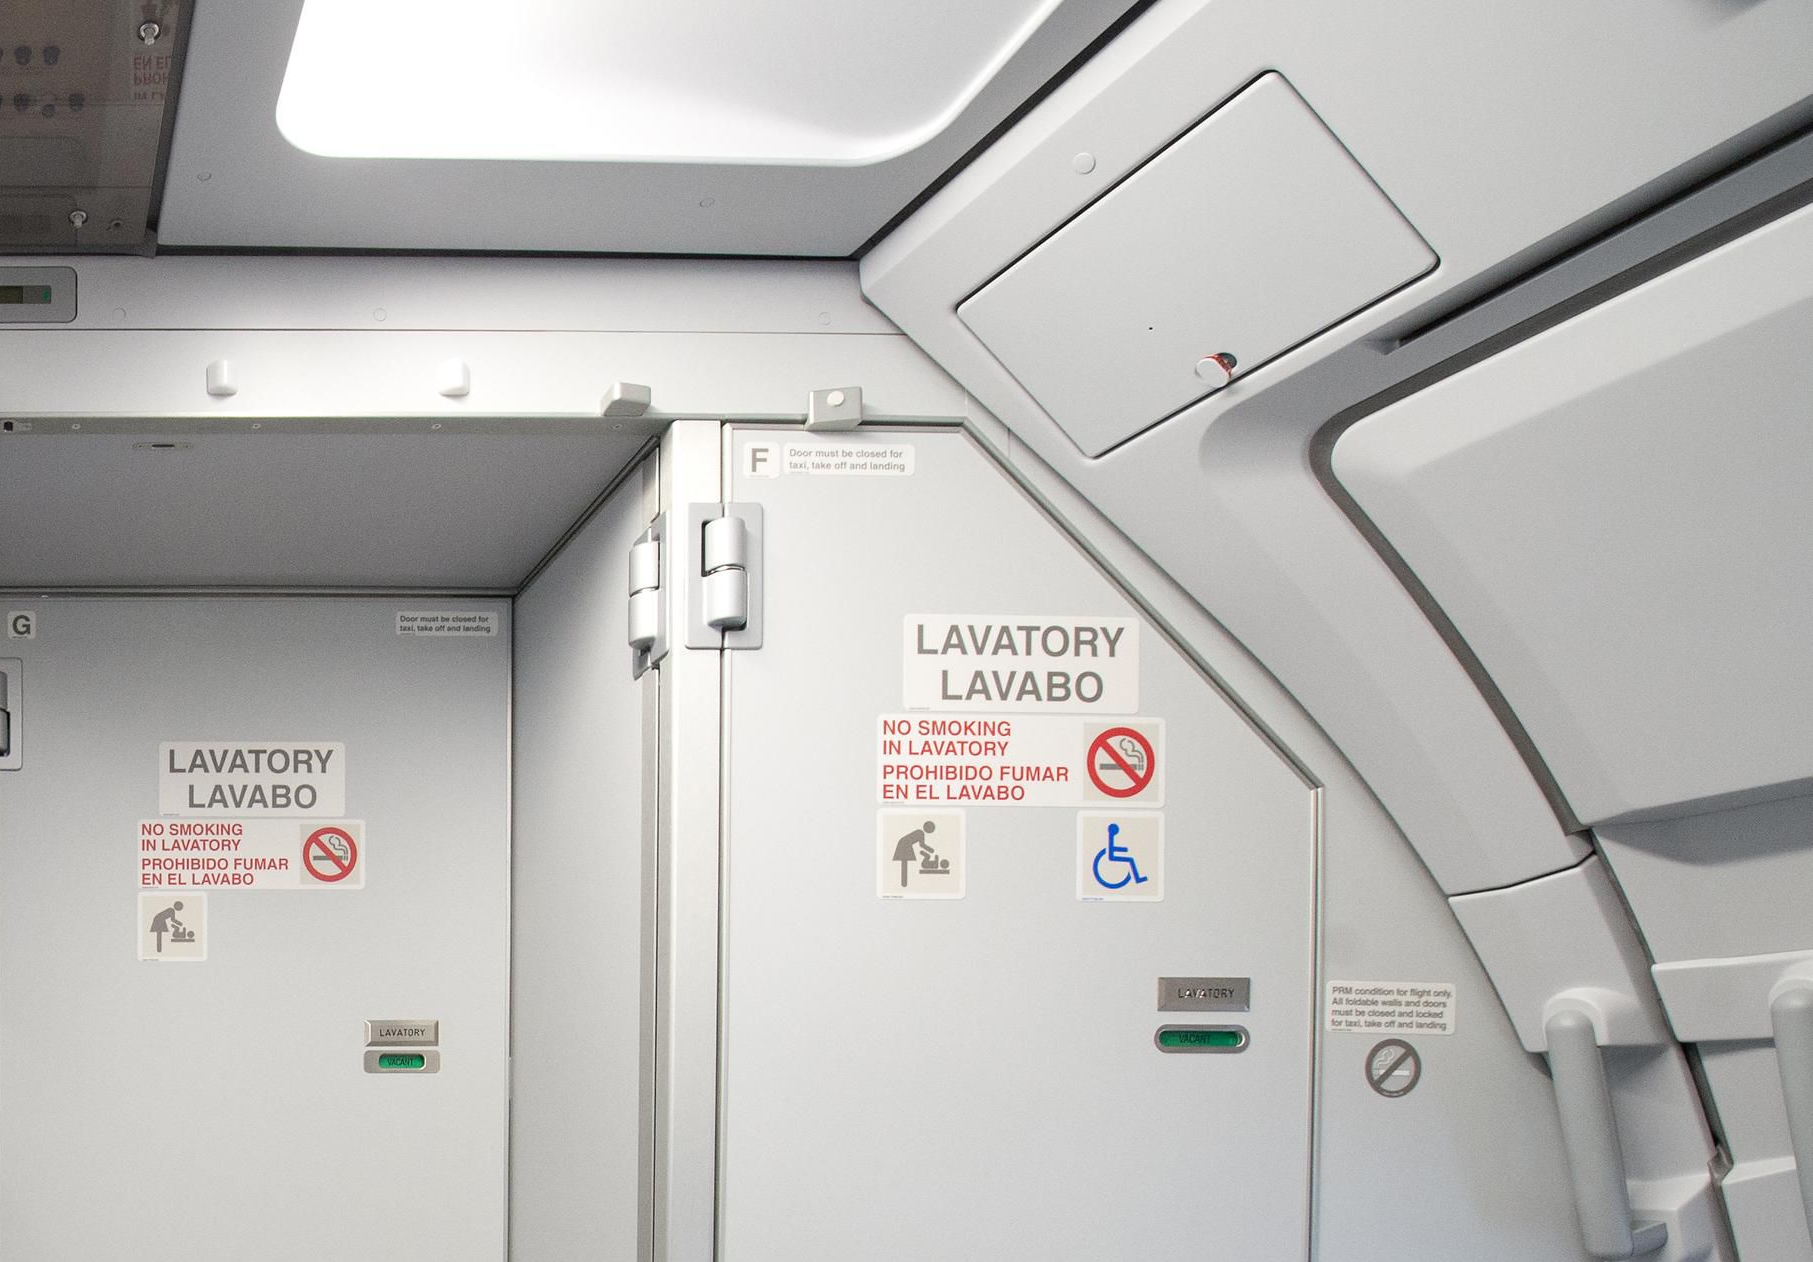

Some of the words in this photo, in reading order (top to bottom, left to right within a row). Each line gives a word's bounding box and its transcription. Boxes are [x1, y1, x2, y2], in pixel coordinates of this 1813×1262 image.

[789, 448, 812, 457] Door
[815, 449, 839, 458] must
[842, 450, 854, 458] be
[856, 450, 887, 458] closed
[890, 450, 903, 458] for
[751, 448, 769, 473] F
[789, 462, 810, 470] taxi,
[811, 462, 832, 470] take
[834, 462, 847, 470] off
[849, 462, 867, 470] and
[870, 462, 905, 472] landing
[12, 614, 30, 636] G
[916, 623, 1125, 658] LAVATORY
[940, 670, 1104, 704] LAVABO
[882, 720, 912, 736] NO
[916, 720, 1012, 738] SMOKING
[882, 740, 902, 757] IN
[907, 740, 1009, 757] LAVATORY
[168, 748, 334, 775] LAVATORY
[882, 764, 993, 782] PROHIBIDO
[999, 765, 1069, 782] FUMAR
[188, 784, 318, 809] LAVABO
[882, 784, 911, 802] EN
[916, 784, 939, 802] EL
[944, 784, 1025, 802] LAVABO
[141, 823, 165, 837] NO
[169, 823, 243, 837] SMOKING
[141, 838, 157, 852] IN
[161, 838, 241, 852] LAVATORY
[141, 858, 228, 872] PROHIBIDO
[233, 858, 289, 872] FUMAR
[141, 873, 163, 886] EN
[167, 873, 186, 886] EL
[190, 873, 254, 886] LAVABO
[1178, 988, 1234, 999] LAVATORY
[1354, 988, 1394, 996] condition
[1410, 988, 1431, 998] flight
[1433, 990, 1453, 999] only.
[1345, 998, 1379, 1006] foldable
[1422, 1000, 1447, 1008] doors
[1355, 1008, 1366, 1016] be
[1368, 1009, 1396, 1017] closed
[1416, 1010, 1444, 1018] locked
[1345, 1019, 1362, 1028] taxi,
[1364, 1020, 1382, 1028] take
[1384, 1020, 1396, 1028] off
[1416, 1021, 1446, 1031] landing
[379, 1028, 426, 1037] LAVATORY
